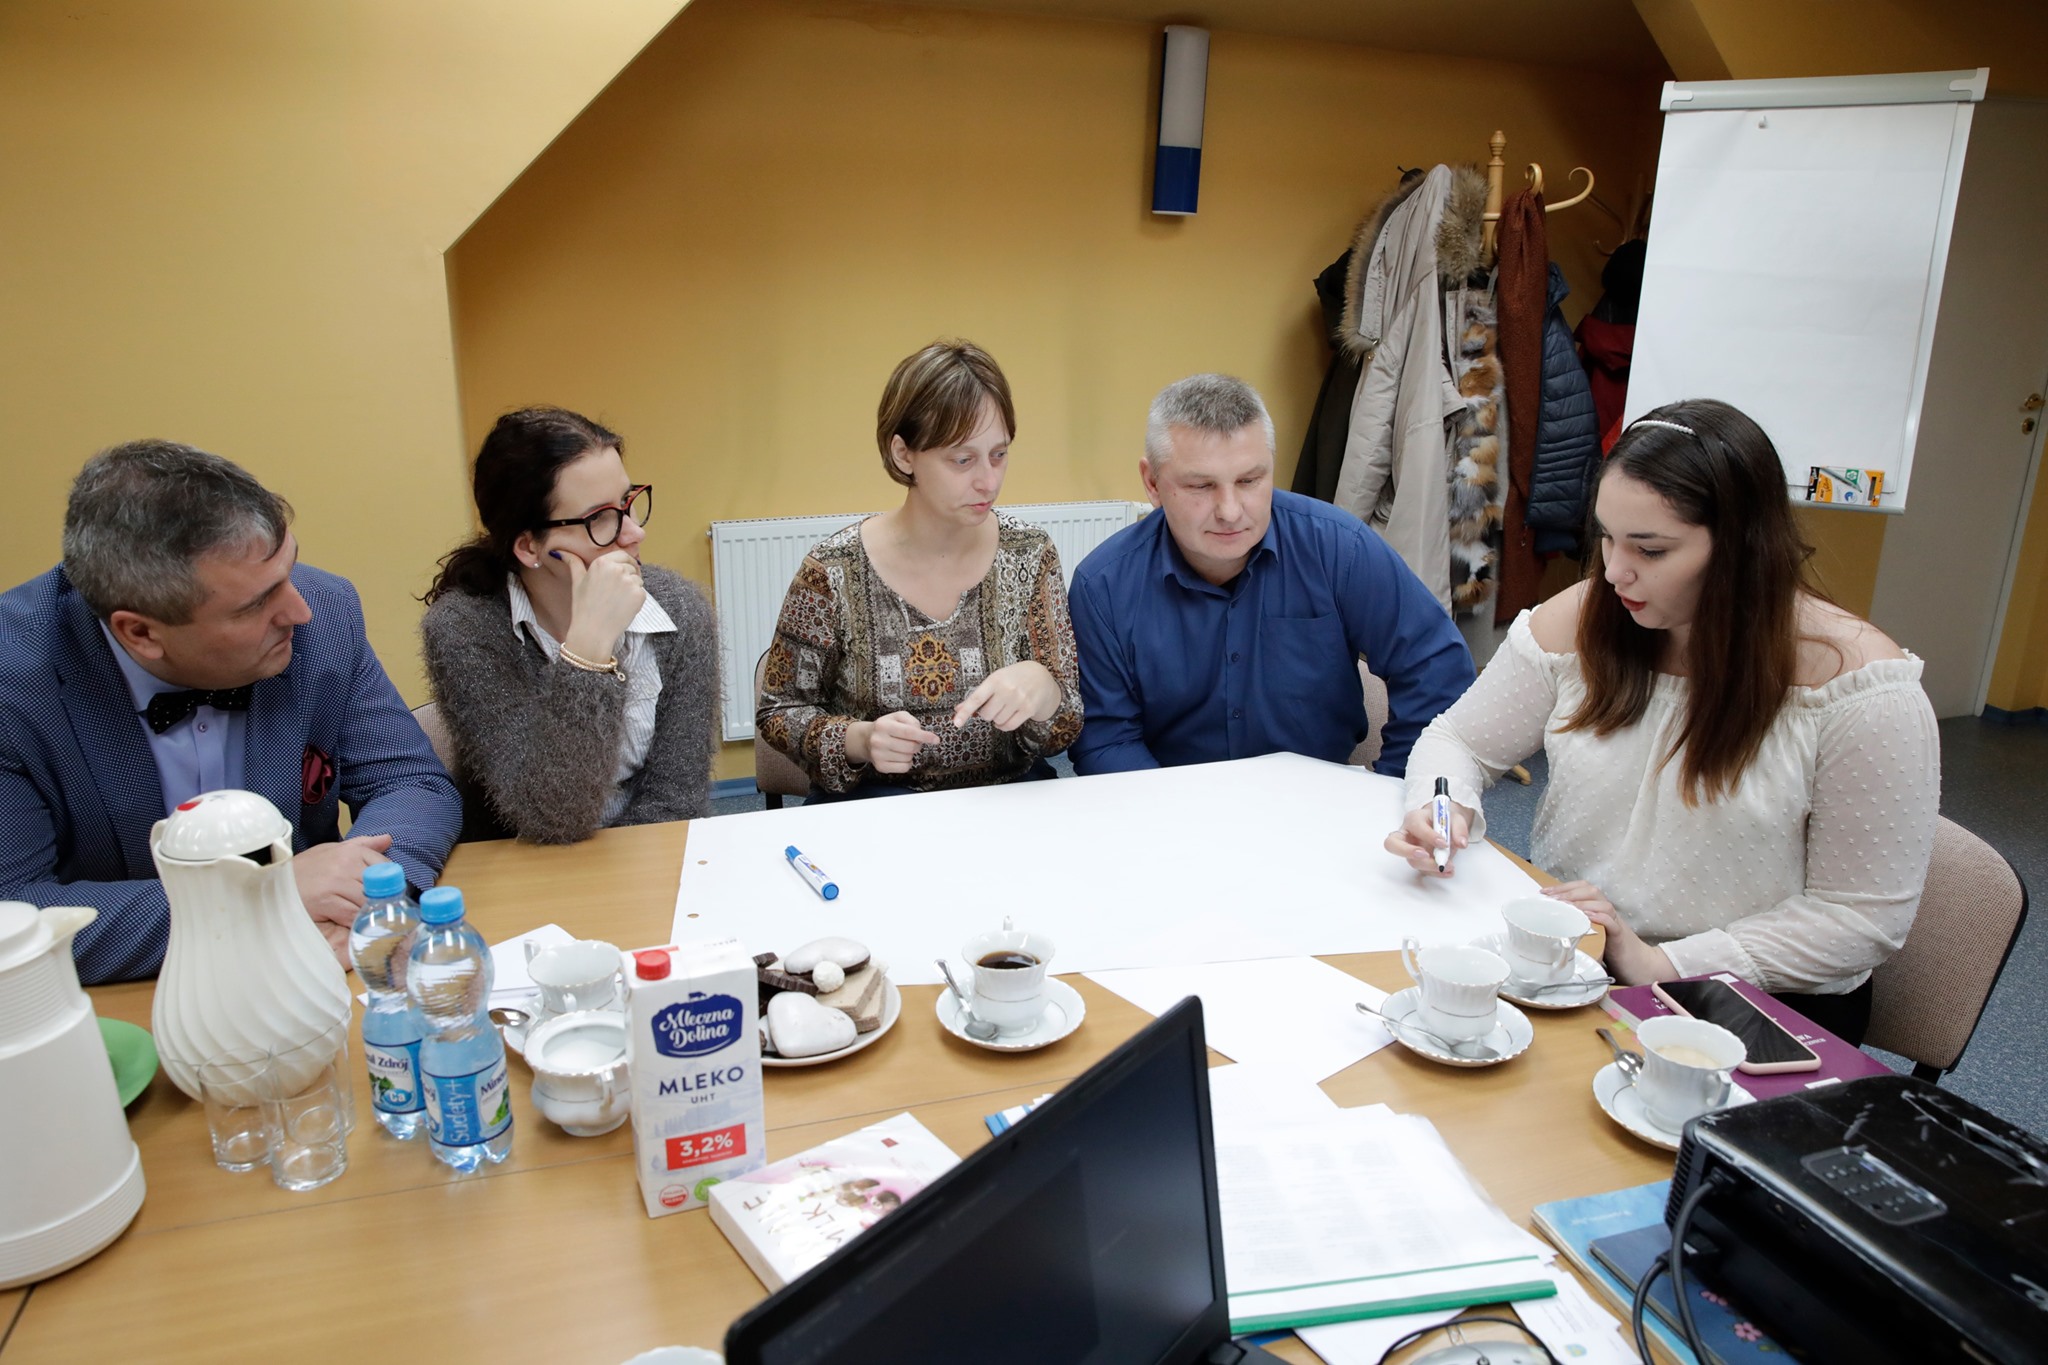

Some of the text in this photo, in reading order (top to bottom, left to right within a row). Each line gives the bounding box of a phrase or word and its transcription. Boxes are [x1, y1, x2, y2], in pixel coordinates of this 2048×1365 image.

[659, 1008, 735, 1031] Mleczna
[669, 1023, 730, 1049] Dolina
[659, 1066, 744, 1096] MLEKO
[444, 1079, 473, 1143] Sudety+
[690, 1093, 716, 1104] UHT
[680, 1132, 734, 1158] 3,2%
